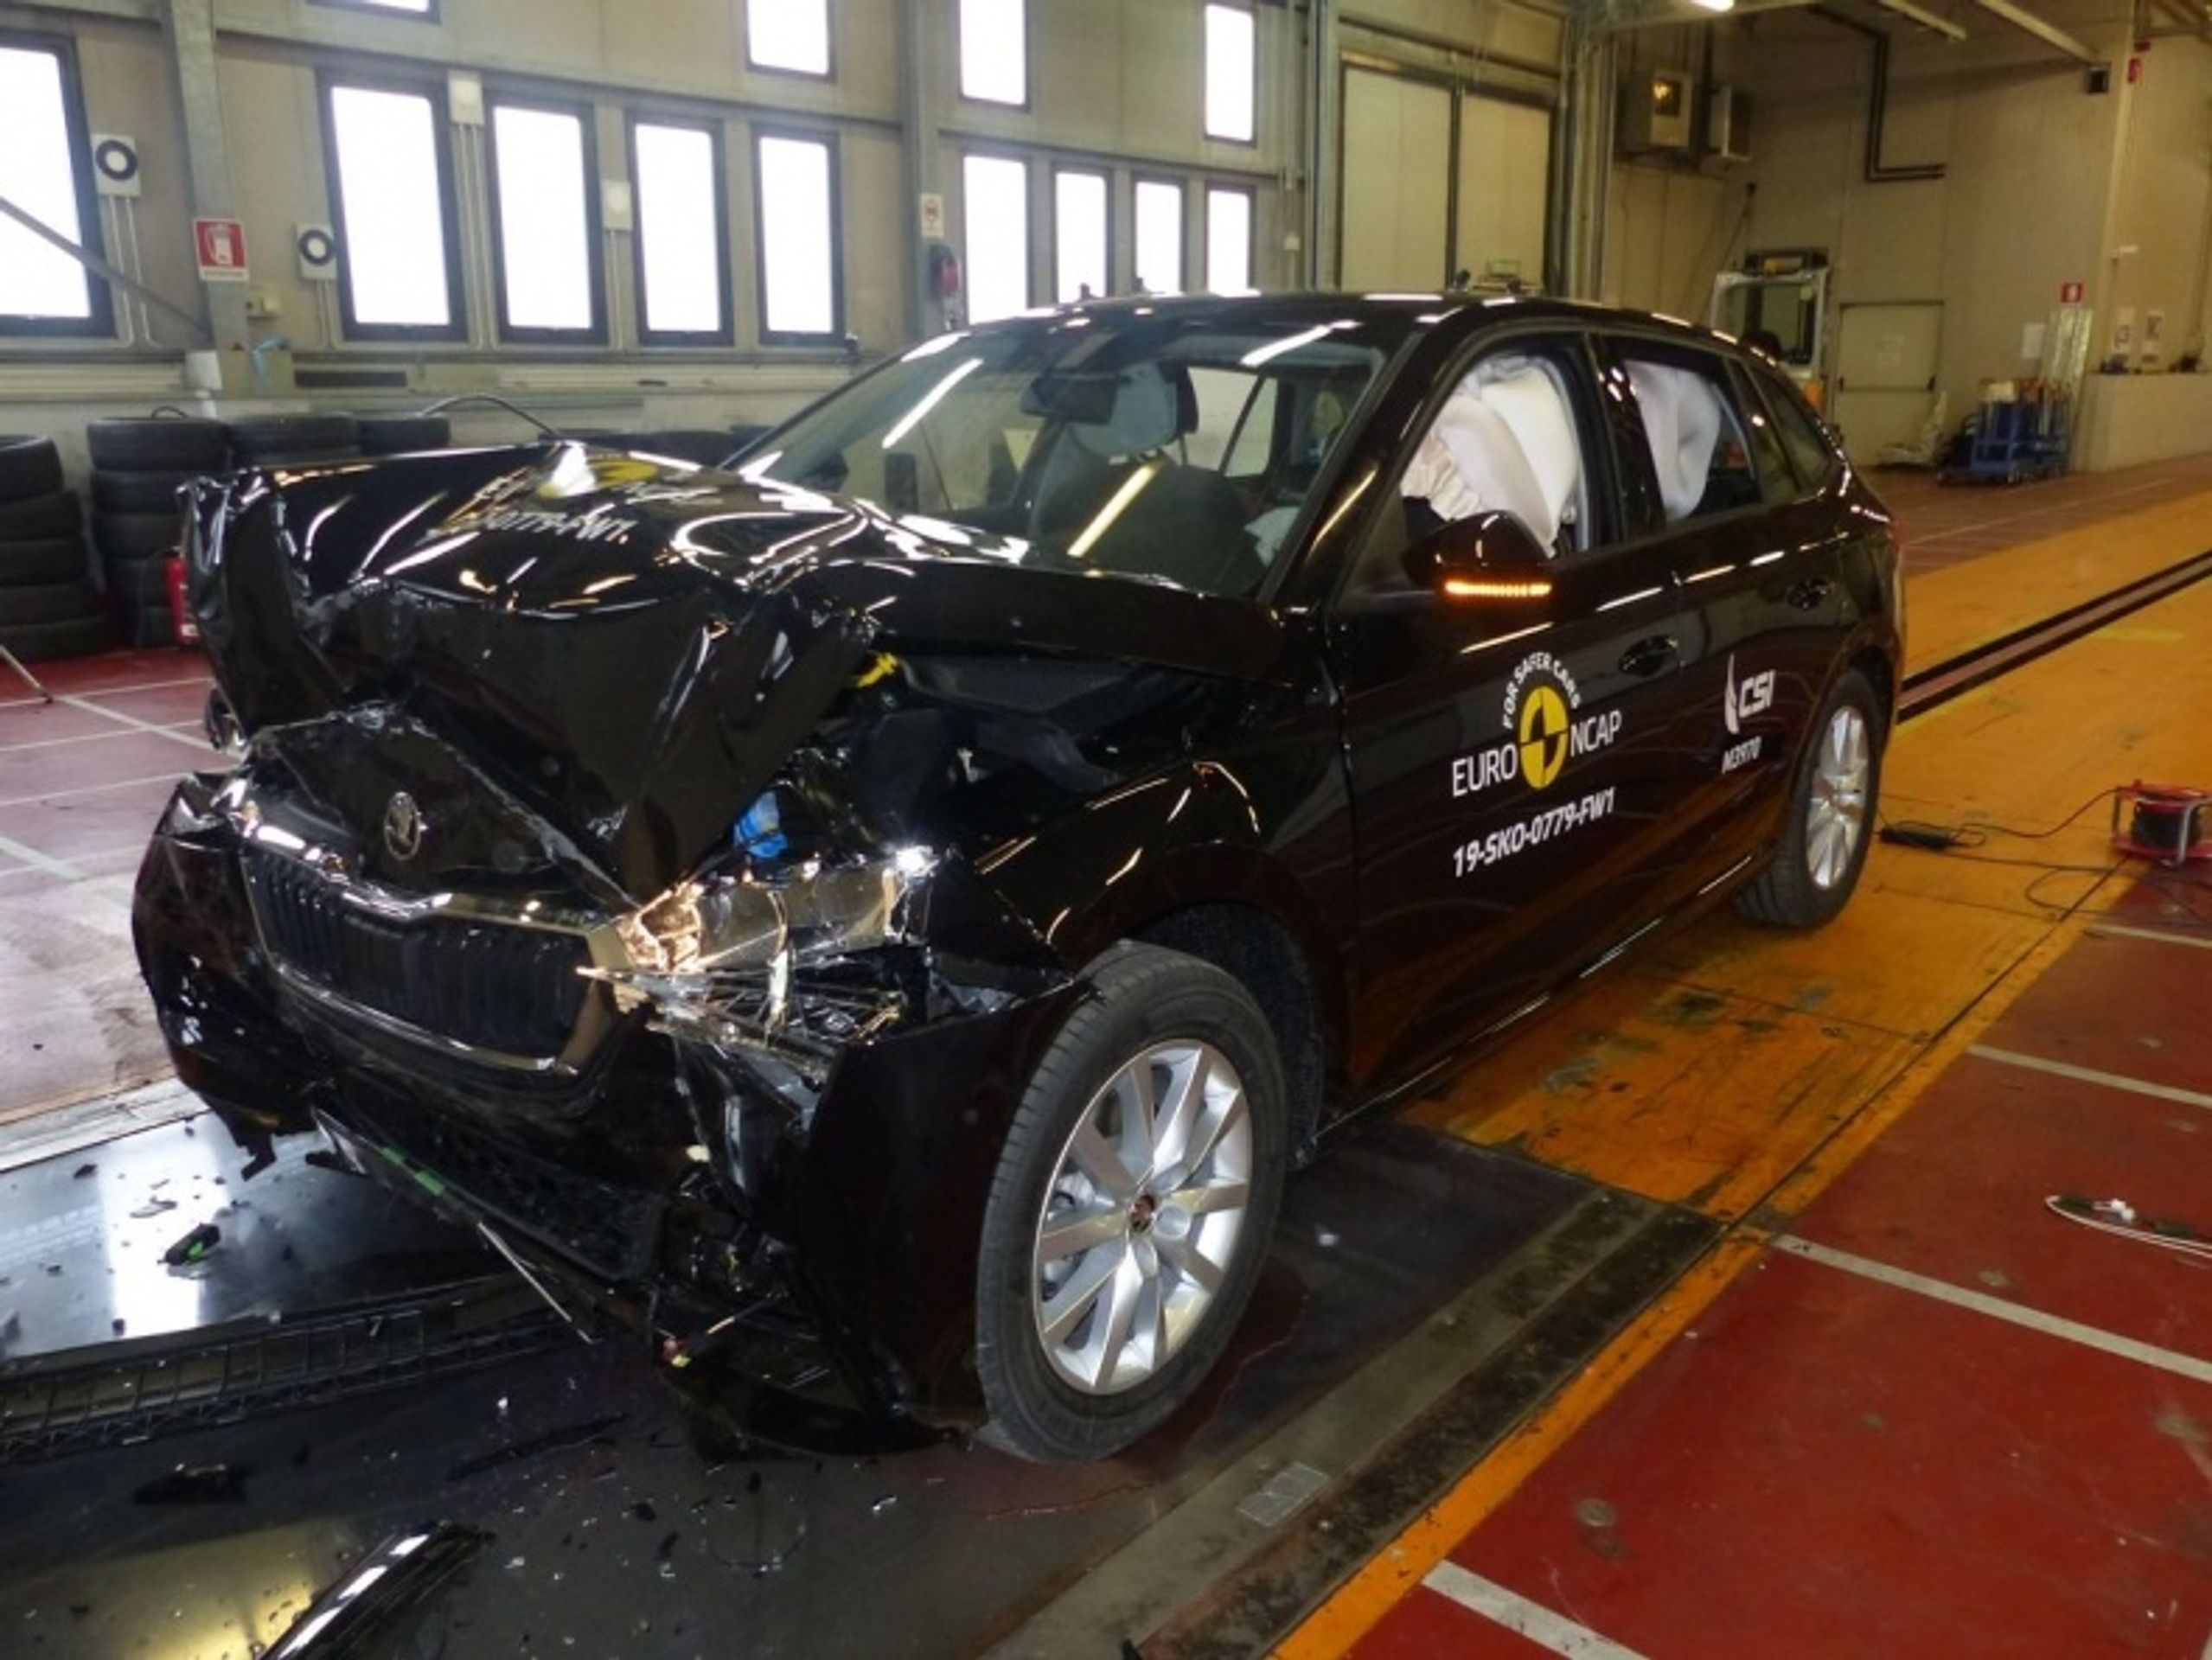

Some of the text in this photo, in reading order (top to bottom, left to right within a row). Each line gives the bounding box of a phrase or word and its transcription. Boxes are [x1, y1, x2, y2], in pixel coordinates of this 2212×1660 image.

[1502, 651, 1581, 730] FOR SAFER CARS
[1738, 669, 1776, 718] CSI
[1452, 709, 1622, 798] EURO NCAP
[1453, 786, 1616, 878] 19-SKO-0779-FW1
